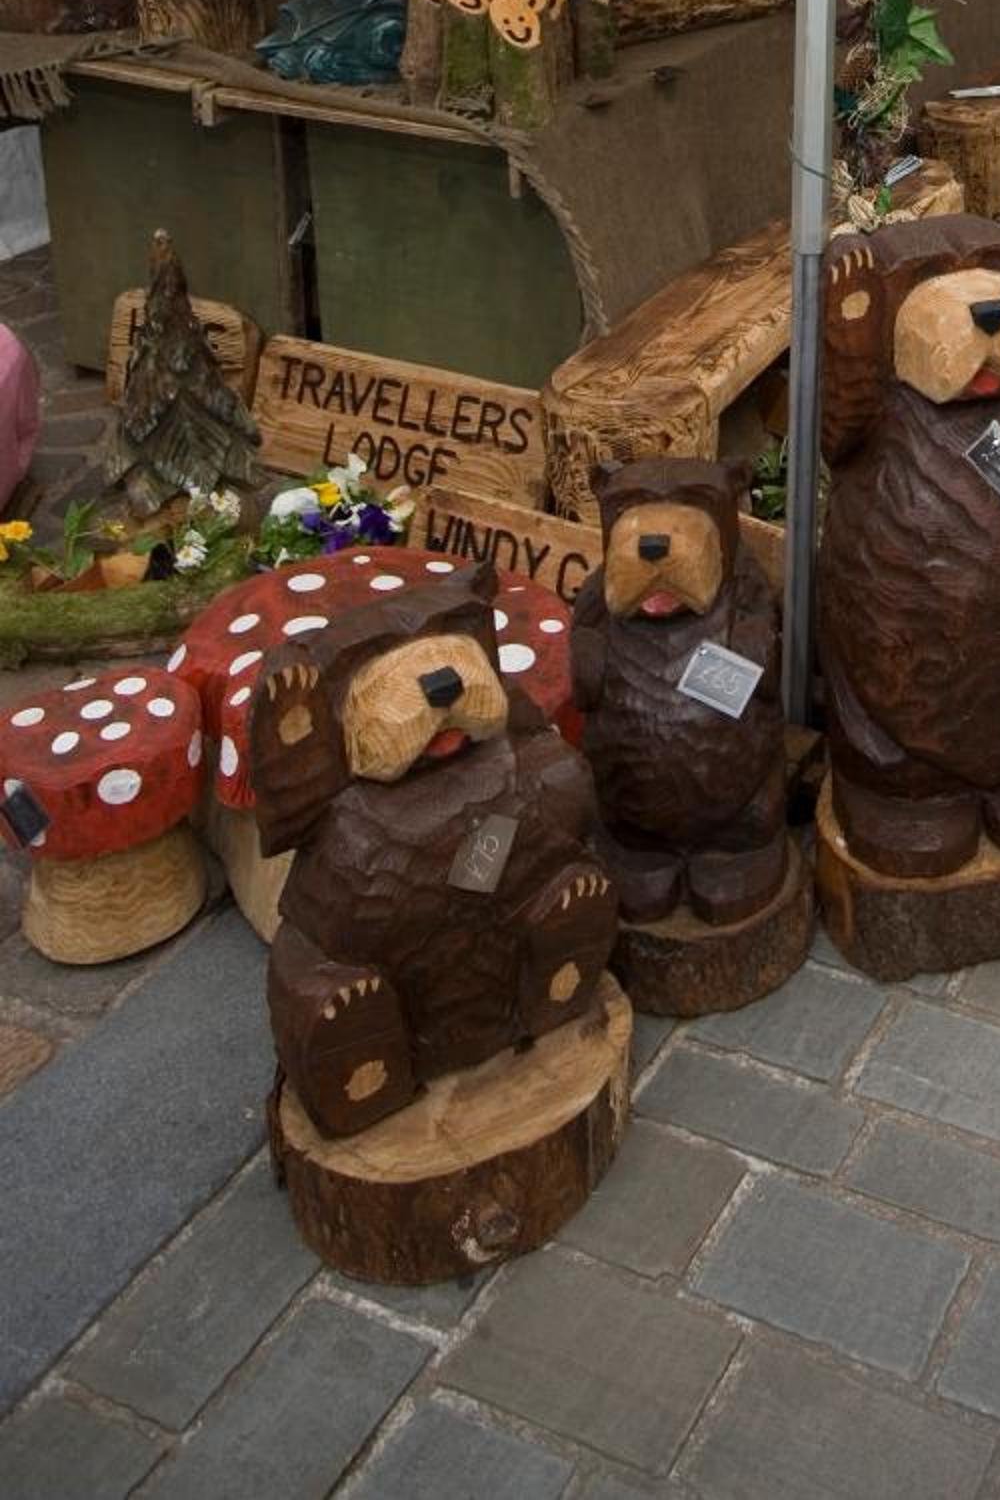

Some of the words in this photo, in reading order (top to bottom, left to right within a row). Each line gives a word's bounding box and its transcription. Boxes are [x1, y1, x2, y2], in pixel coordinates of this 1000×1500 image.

[278, 356, 534, 455] TRAVELLERS
[322, 423, 459, 488] LODGE
[425, 508, 551, 581] WINDY
